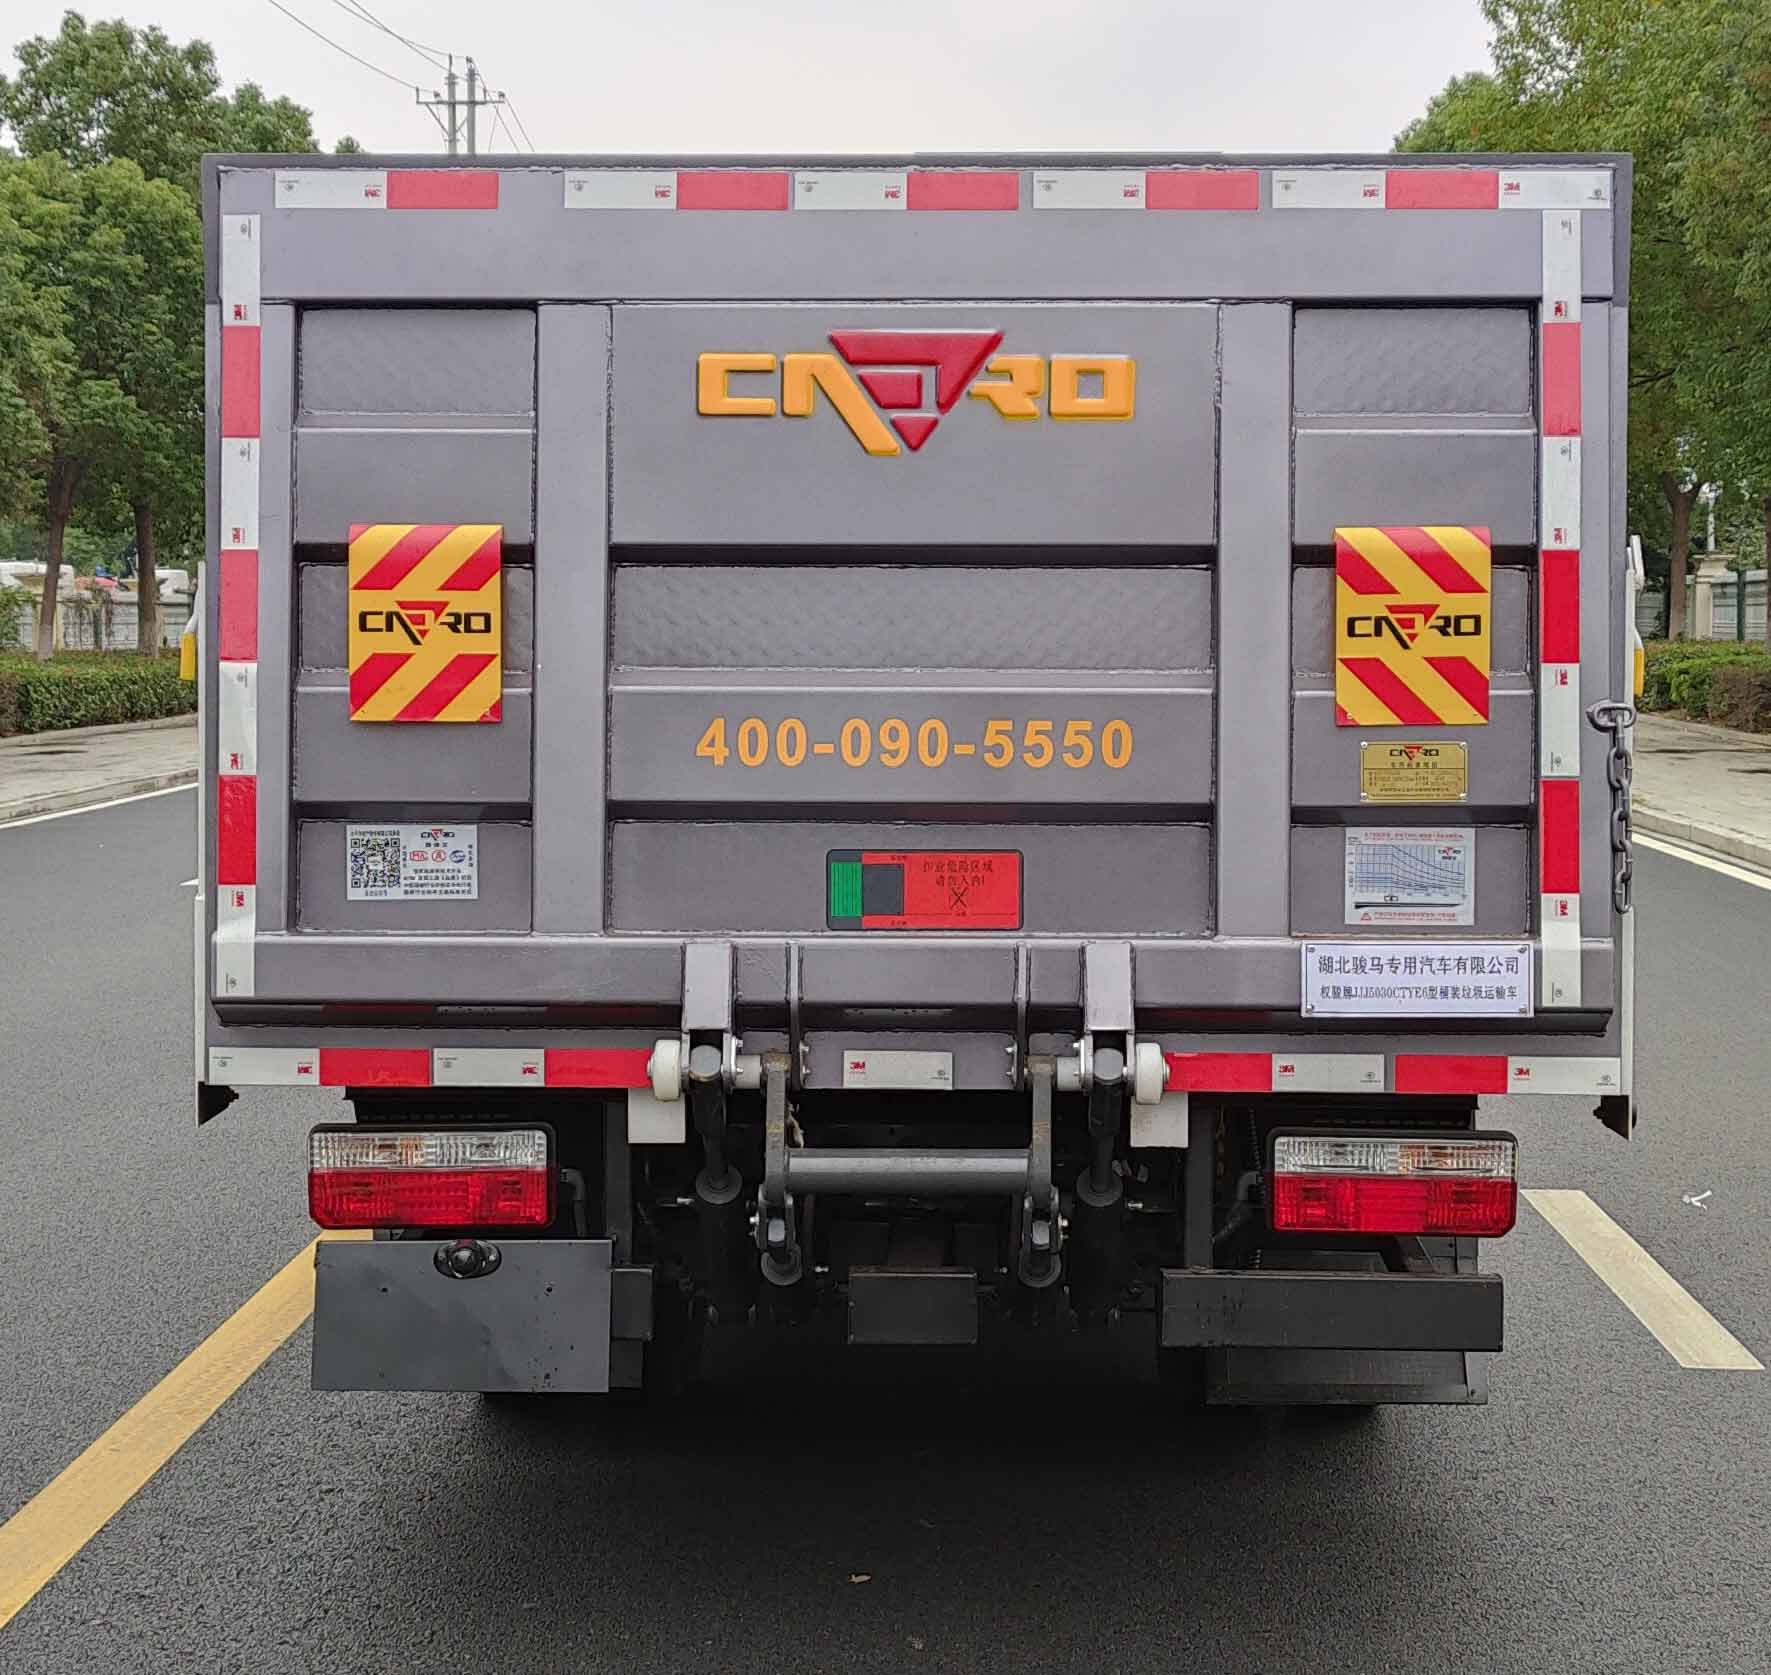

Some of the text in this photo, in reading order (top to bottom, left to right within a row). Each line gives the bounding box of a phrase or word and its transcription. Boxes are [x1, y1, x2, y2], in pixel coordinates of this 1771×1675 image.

[696, 718, 1134, 769] 400-090-5550
[1318, 954, 1520, 976] 湖北骏马专用汽车有限公司
